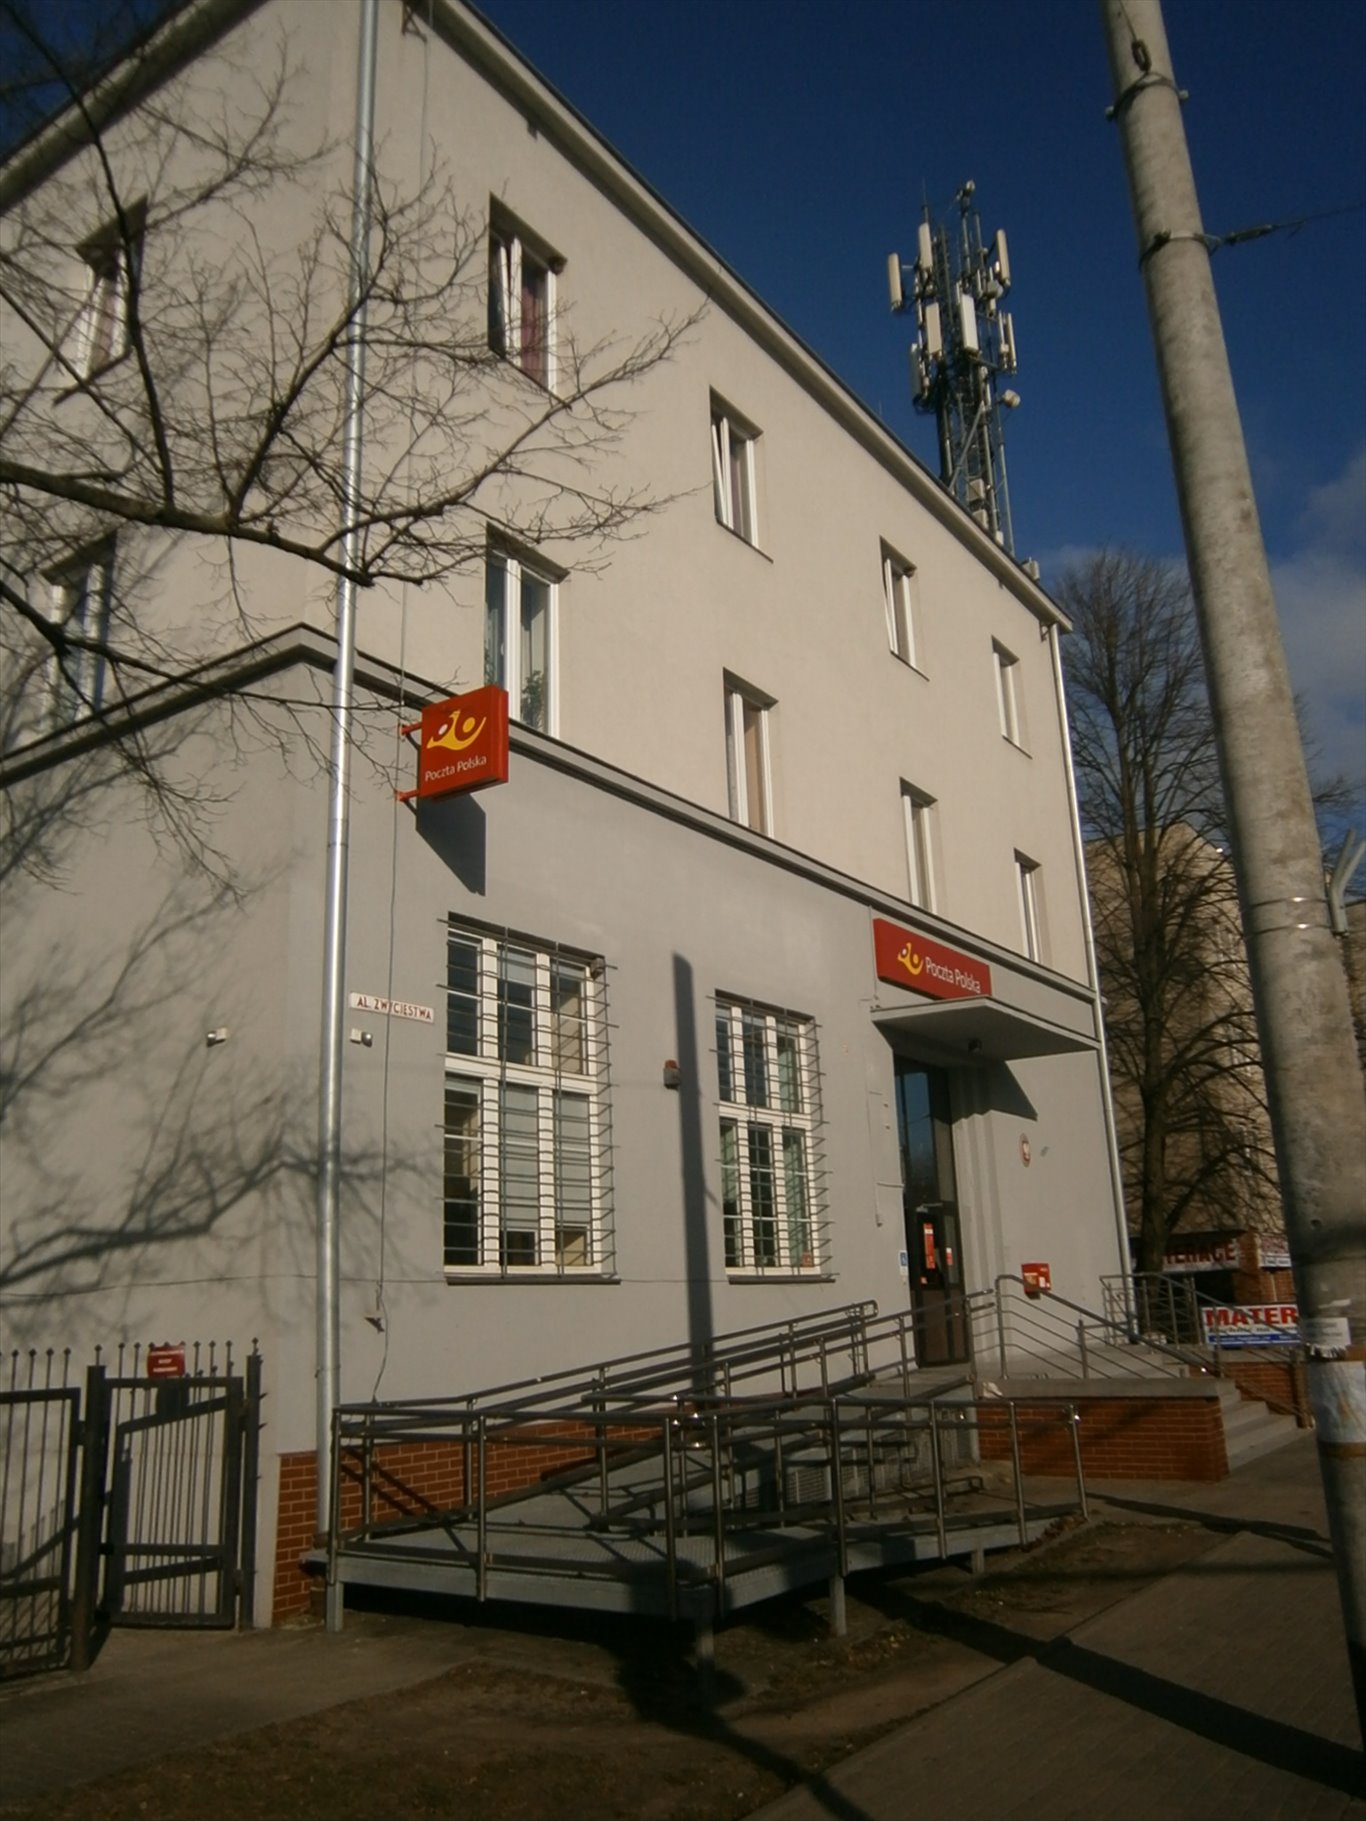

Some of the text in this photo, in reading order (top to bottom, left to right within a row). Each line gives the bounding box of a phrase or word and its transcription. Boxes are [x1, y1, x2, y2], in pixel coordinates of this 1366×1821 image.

[425, 755, 487, 781] Poczta Polska
[925, 956, 981, 994] Poczta Polska
